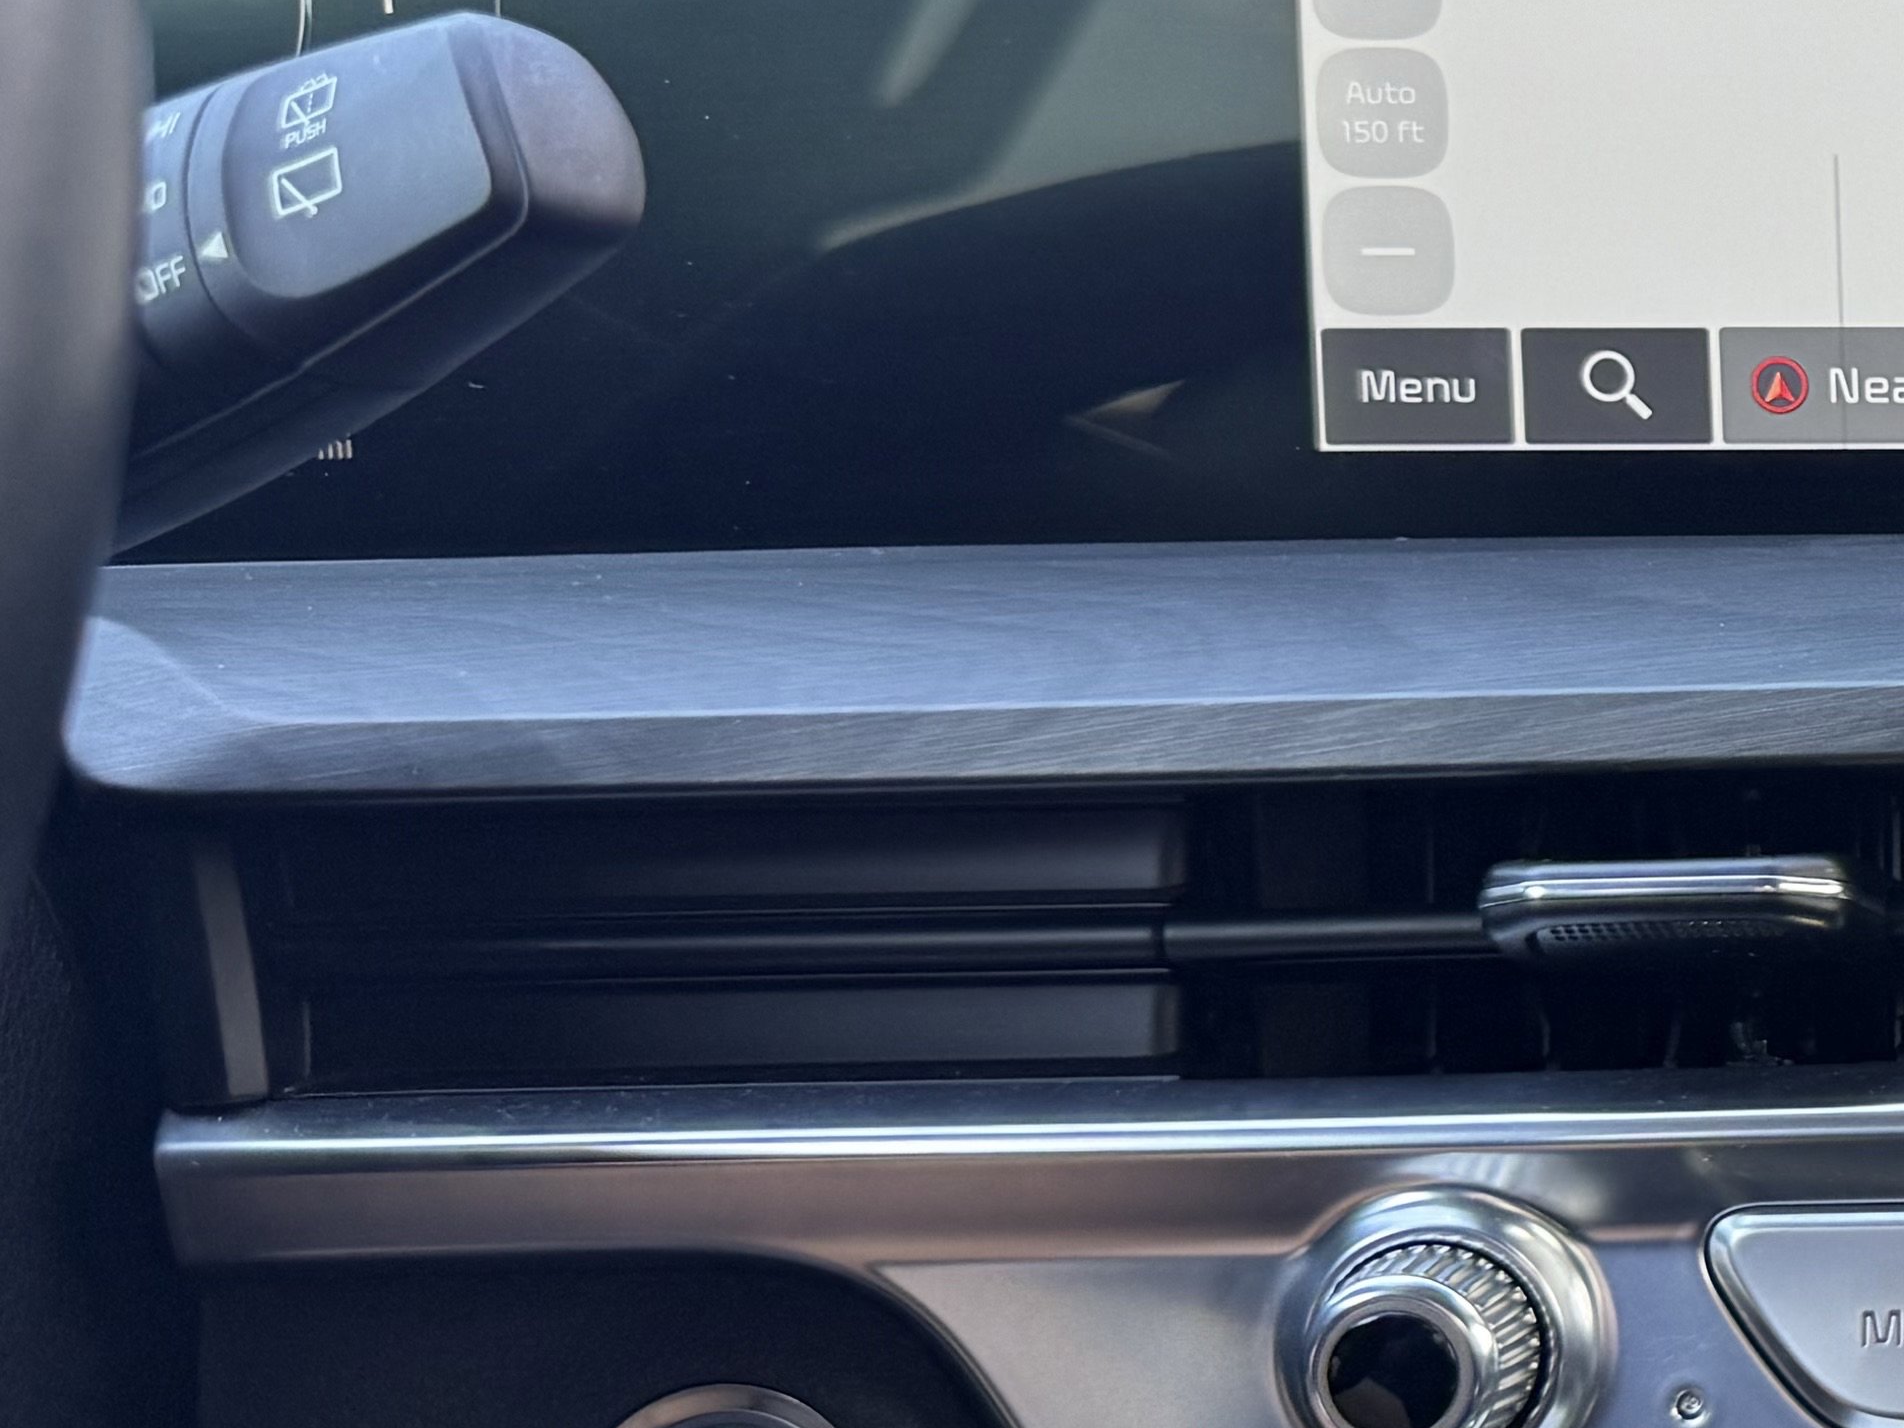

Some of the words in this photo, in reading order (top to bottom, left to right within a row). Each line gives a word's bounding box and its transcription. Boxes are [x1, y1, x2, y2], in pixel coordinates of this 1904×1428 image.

[1346, 81, 1417, 106] Auto
[283, 119, 327, 149] PUSH
[1343, 119, 1390, 145] 150
[1395, 118, 1425, 144] ft
[137, 255, 187, 303] OFF
[1361, 369, 1477, 405] Menu
